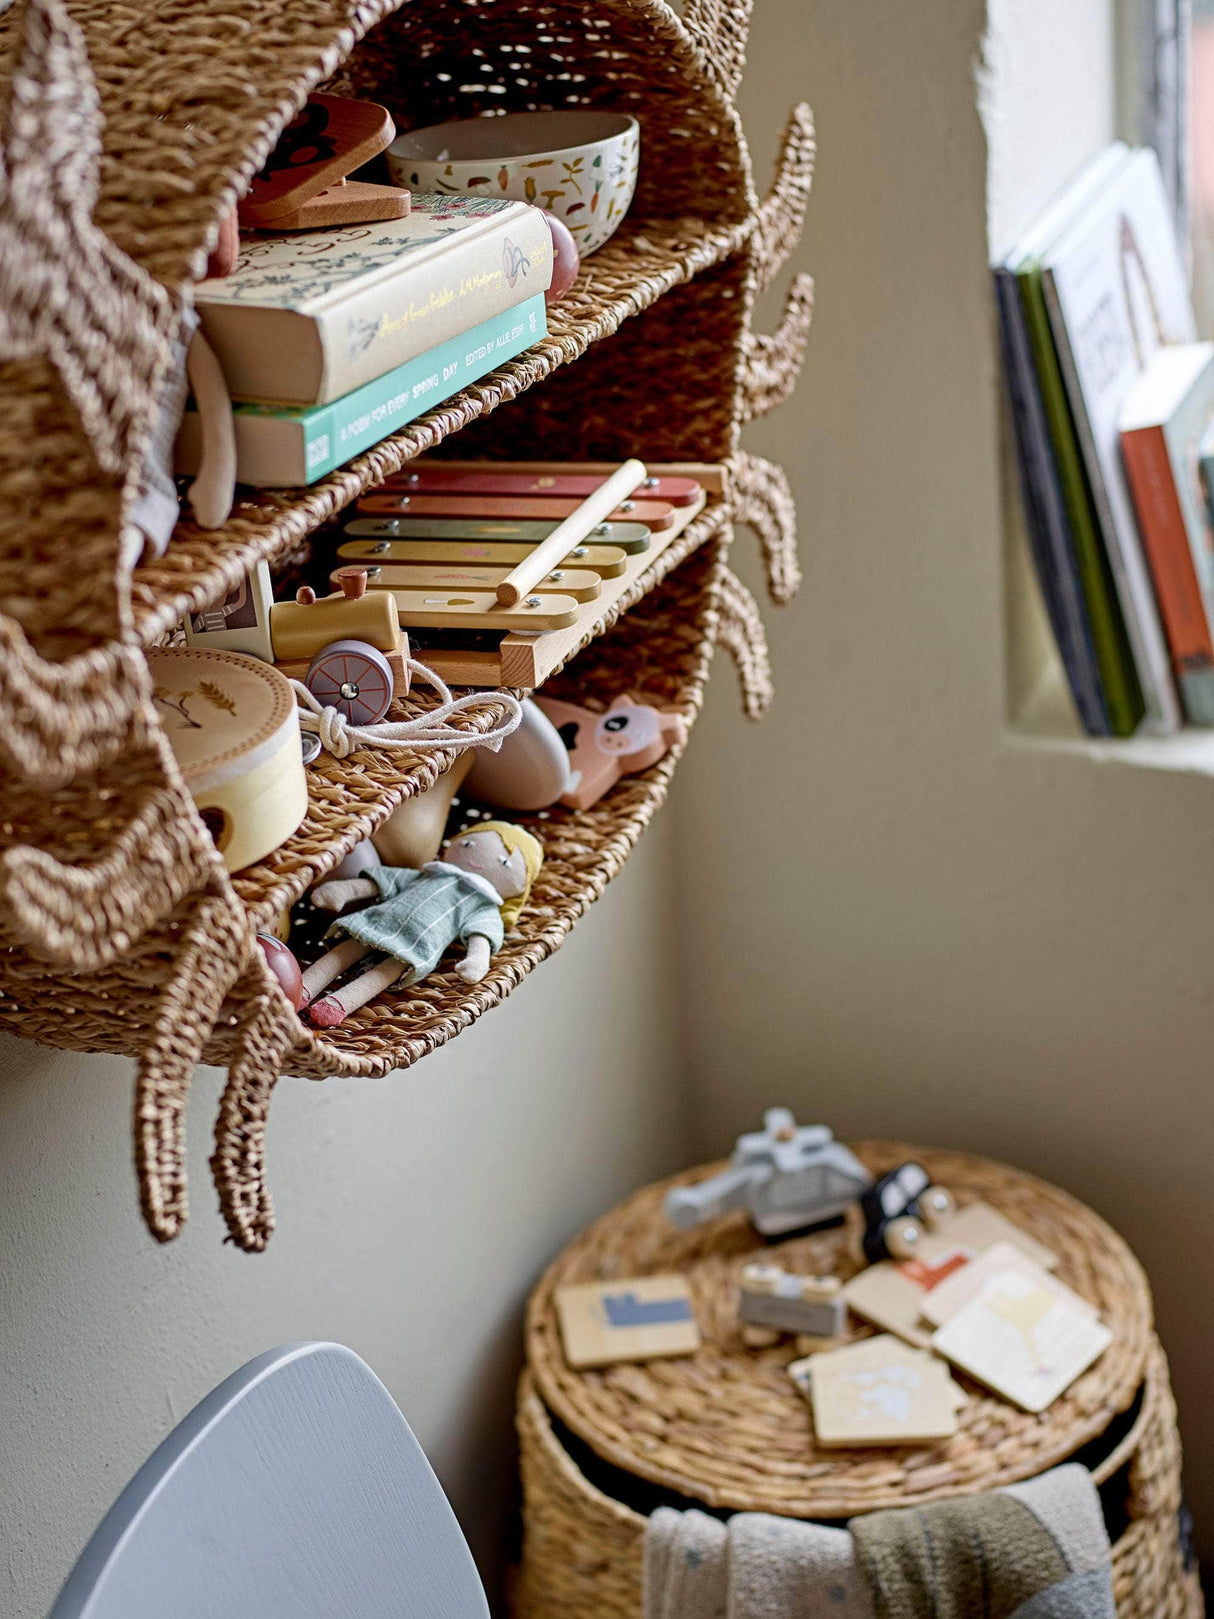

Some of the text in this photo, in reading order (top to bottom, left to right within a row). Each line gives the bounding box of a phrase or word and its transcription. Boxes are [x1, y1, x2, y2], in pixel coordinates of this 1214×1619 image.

[465, 346, 486, 367] EDITED
[486, 341, 495, 354] BY
[495, 331, 511, 350] ALLIE
[412, 373, 439, 399] SPRING
[443, 361, 458, 381] DAY
